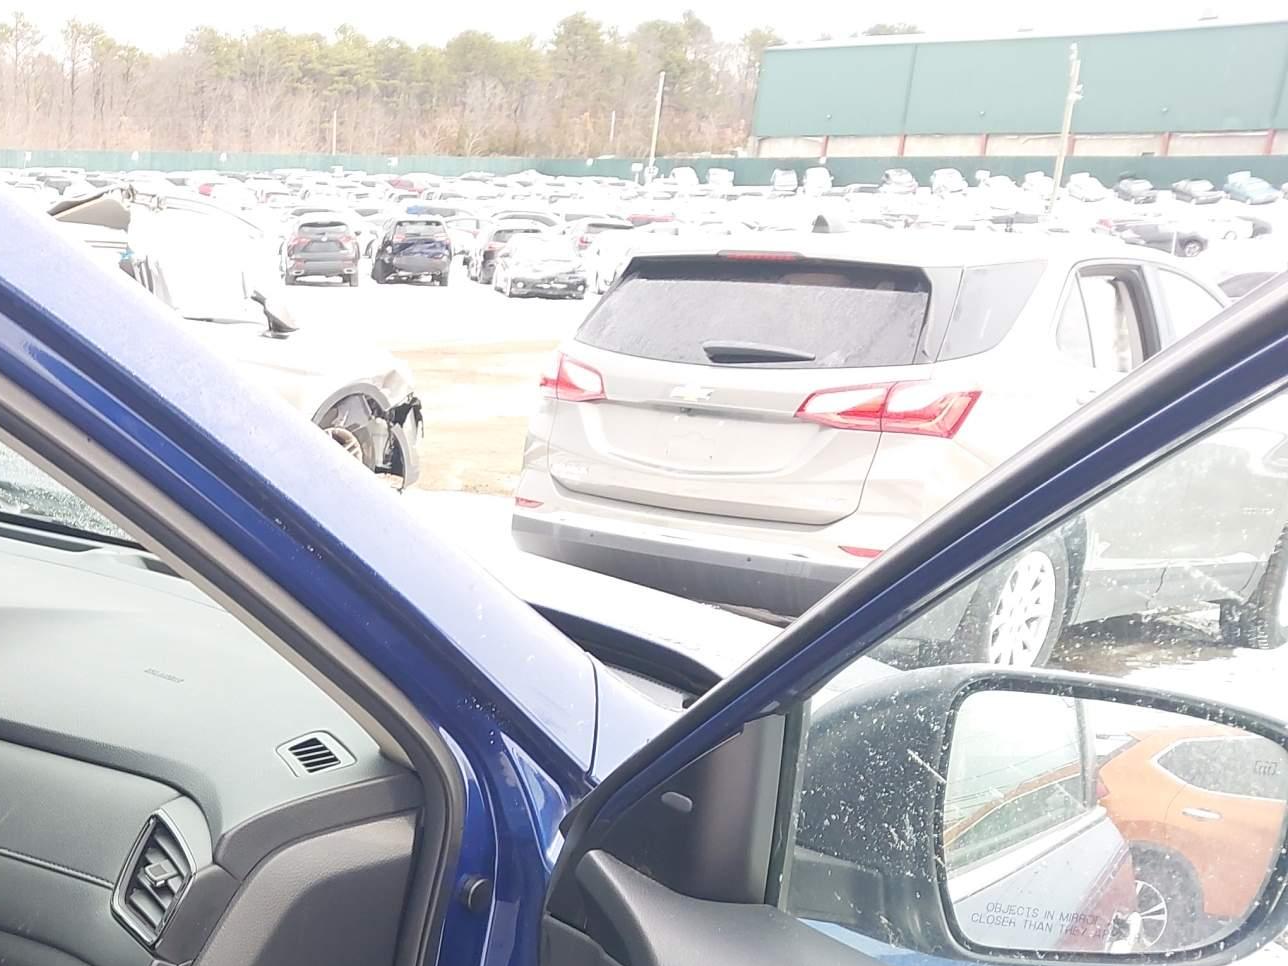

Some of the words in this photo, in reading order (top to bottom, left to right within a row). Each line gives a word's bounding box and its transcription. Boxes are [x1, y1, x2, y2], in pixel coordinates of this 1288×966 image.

[986, 902, 1040, 918] OBJECTS
[1043, 909, 1055, 920] IN
[1023, 919, 1053, 934] THAN
